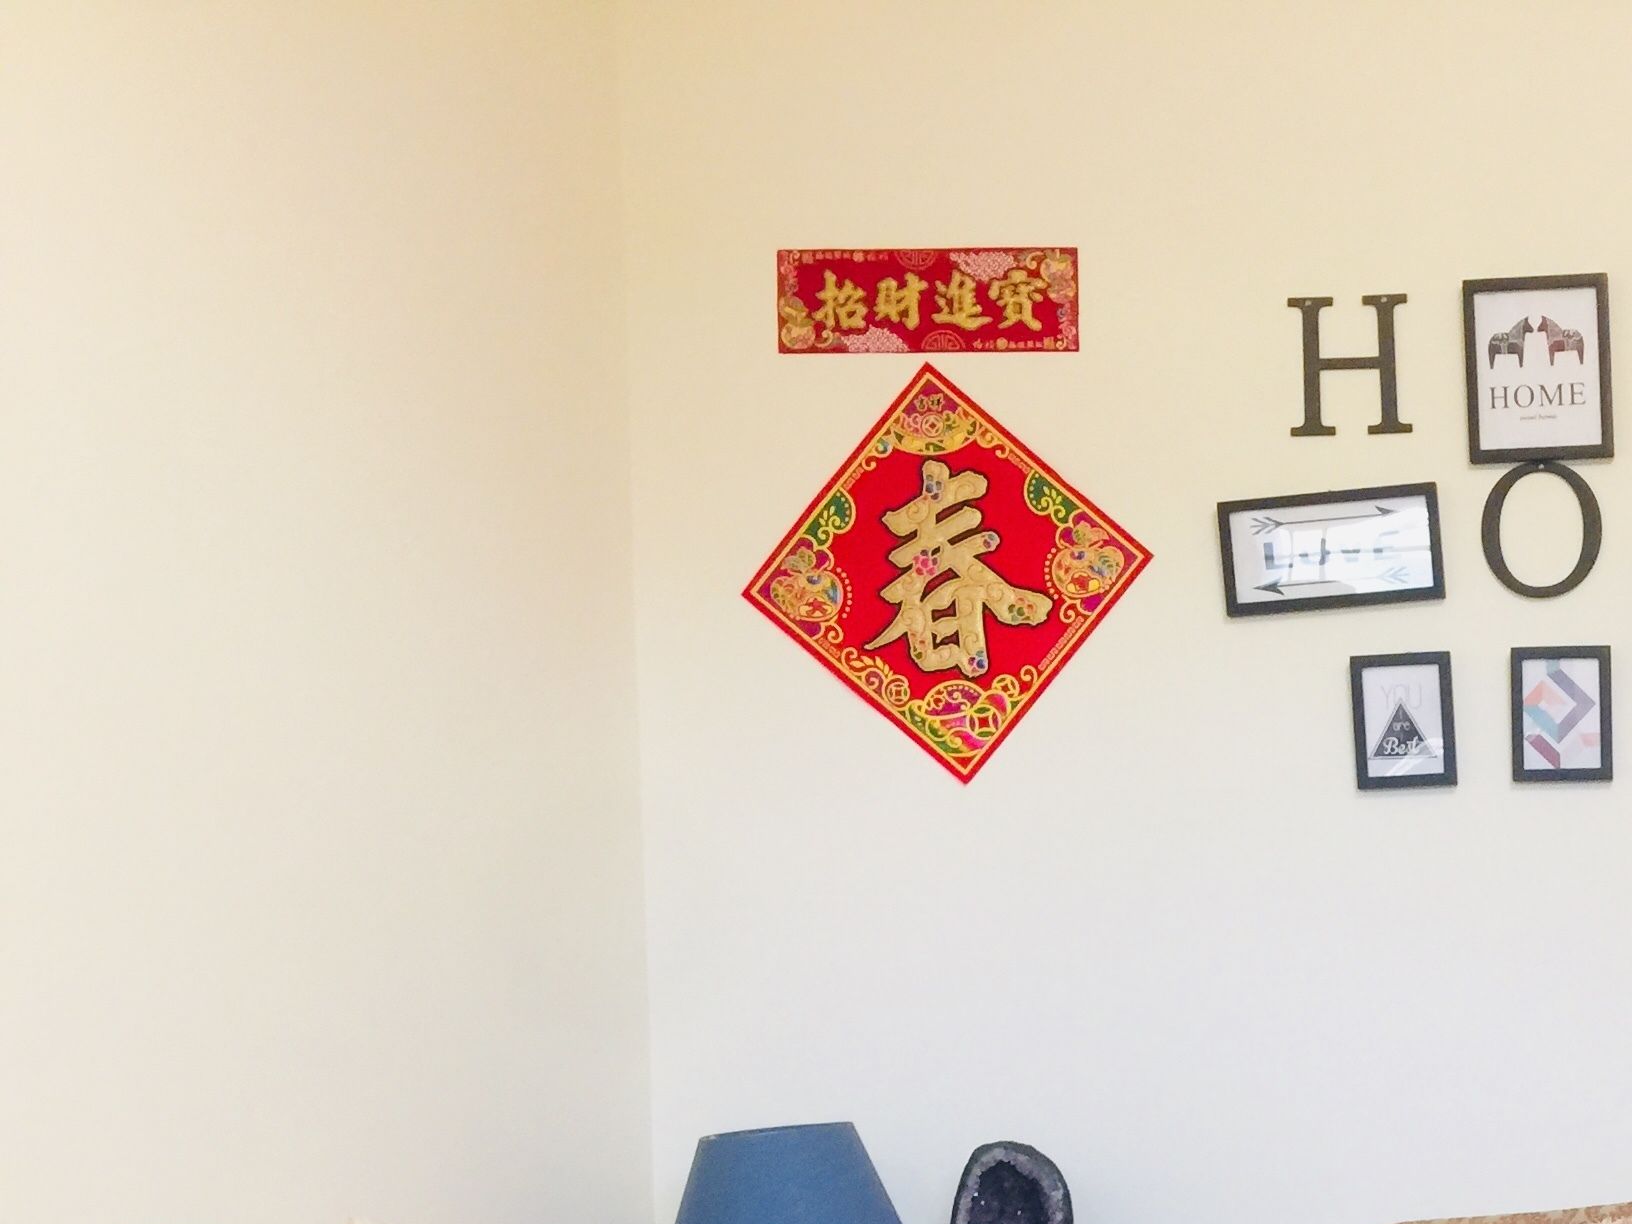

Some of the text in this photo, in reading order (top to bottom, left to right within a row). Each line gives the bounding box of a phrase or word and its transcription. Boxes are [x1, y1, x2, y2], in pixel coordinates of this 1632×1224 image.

[811, 268, 1048, 331] 招財進寶
[1489, 382, 1587, 410] HOME
[864, 458, 1054, 679] 春
